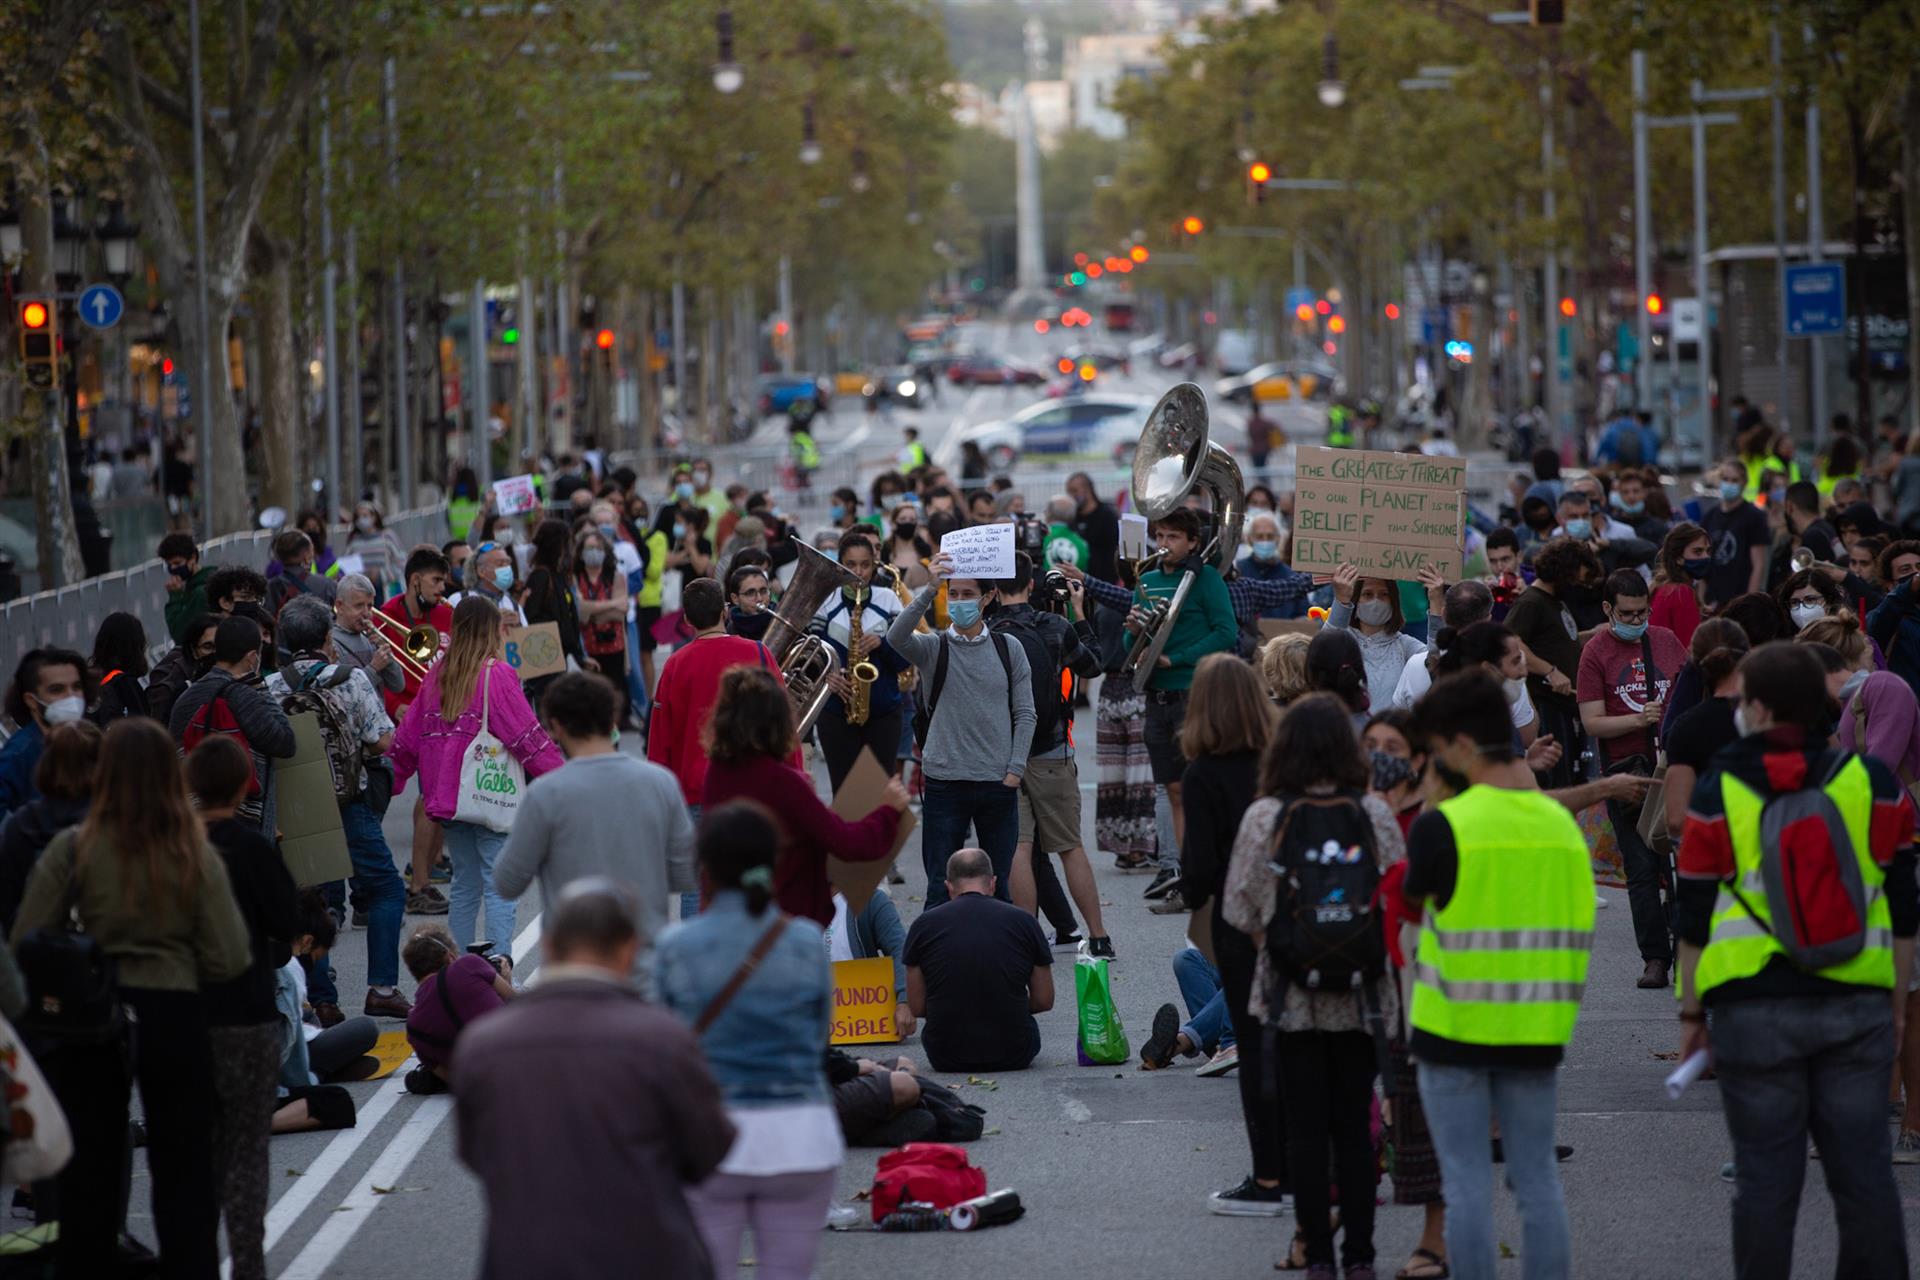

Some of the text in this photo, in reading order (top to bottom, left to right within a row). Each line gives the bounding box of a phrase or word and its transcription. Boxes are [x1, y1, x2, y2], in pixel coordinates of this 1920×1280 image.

[1300, 457, 1465, 486] THE GREATEST THREAT
[1300, 490, 1316, 500] TO
[1326, 495, 1348, 504] OUR
[1360, 488, 1428, 511] PLANET
[1298, 510, 1458, 536] BELIEF THAT SOMEONE
[1296, 539, 1449, 571] ELSE WILL SAVE IT
[505, 641, 522, 669] B
